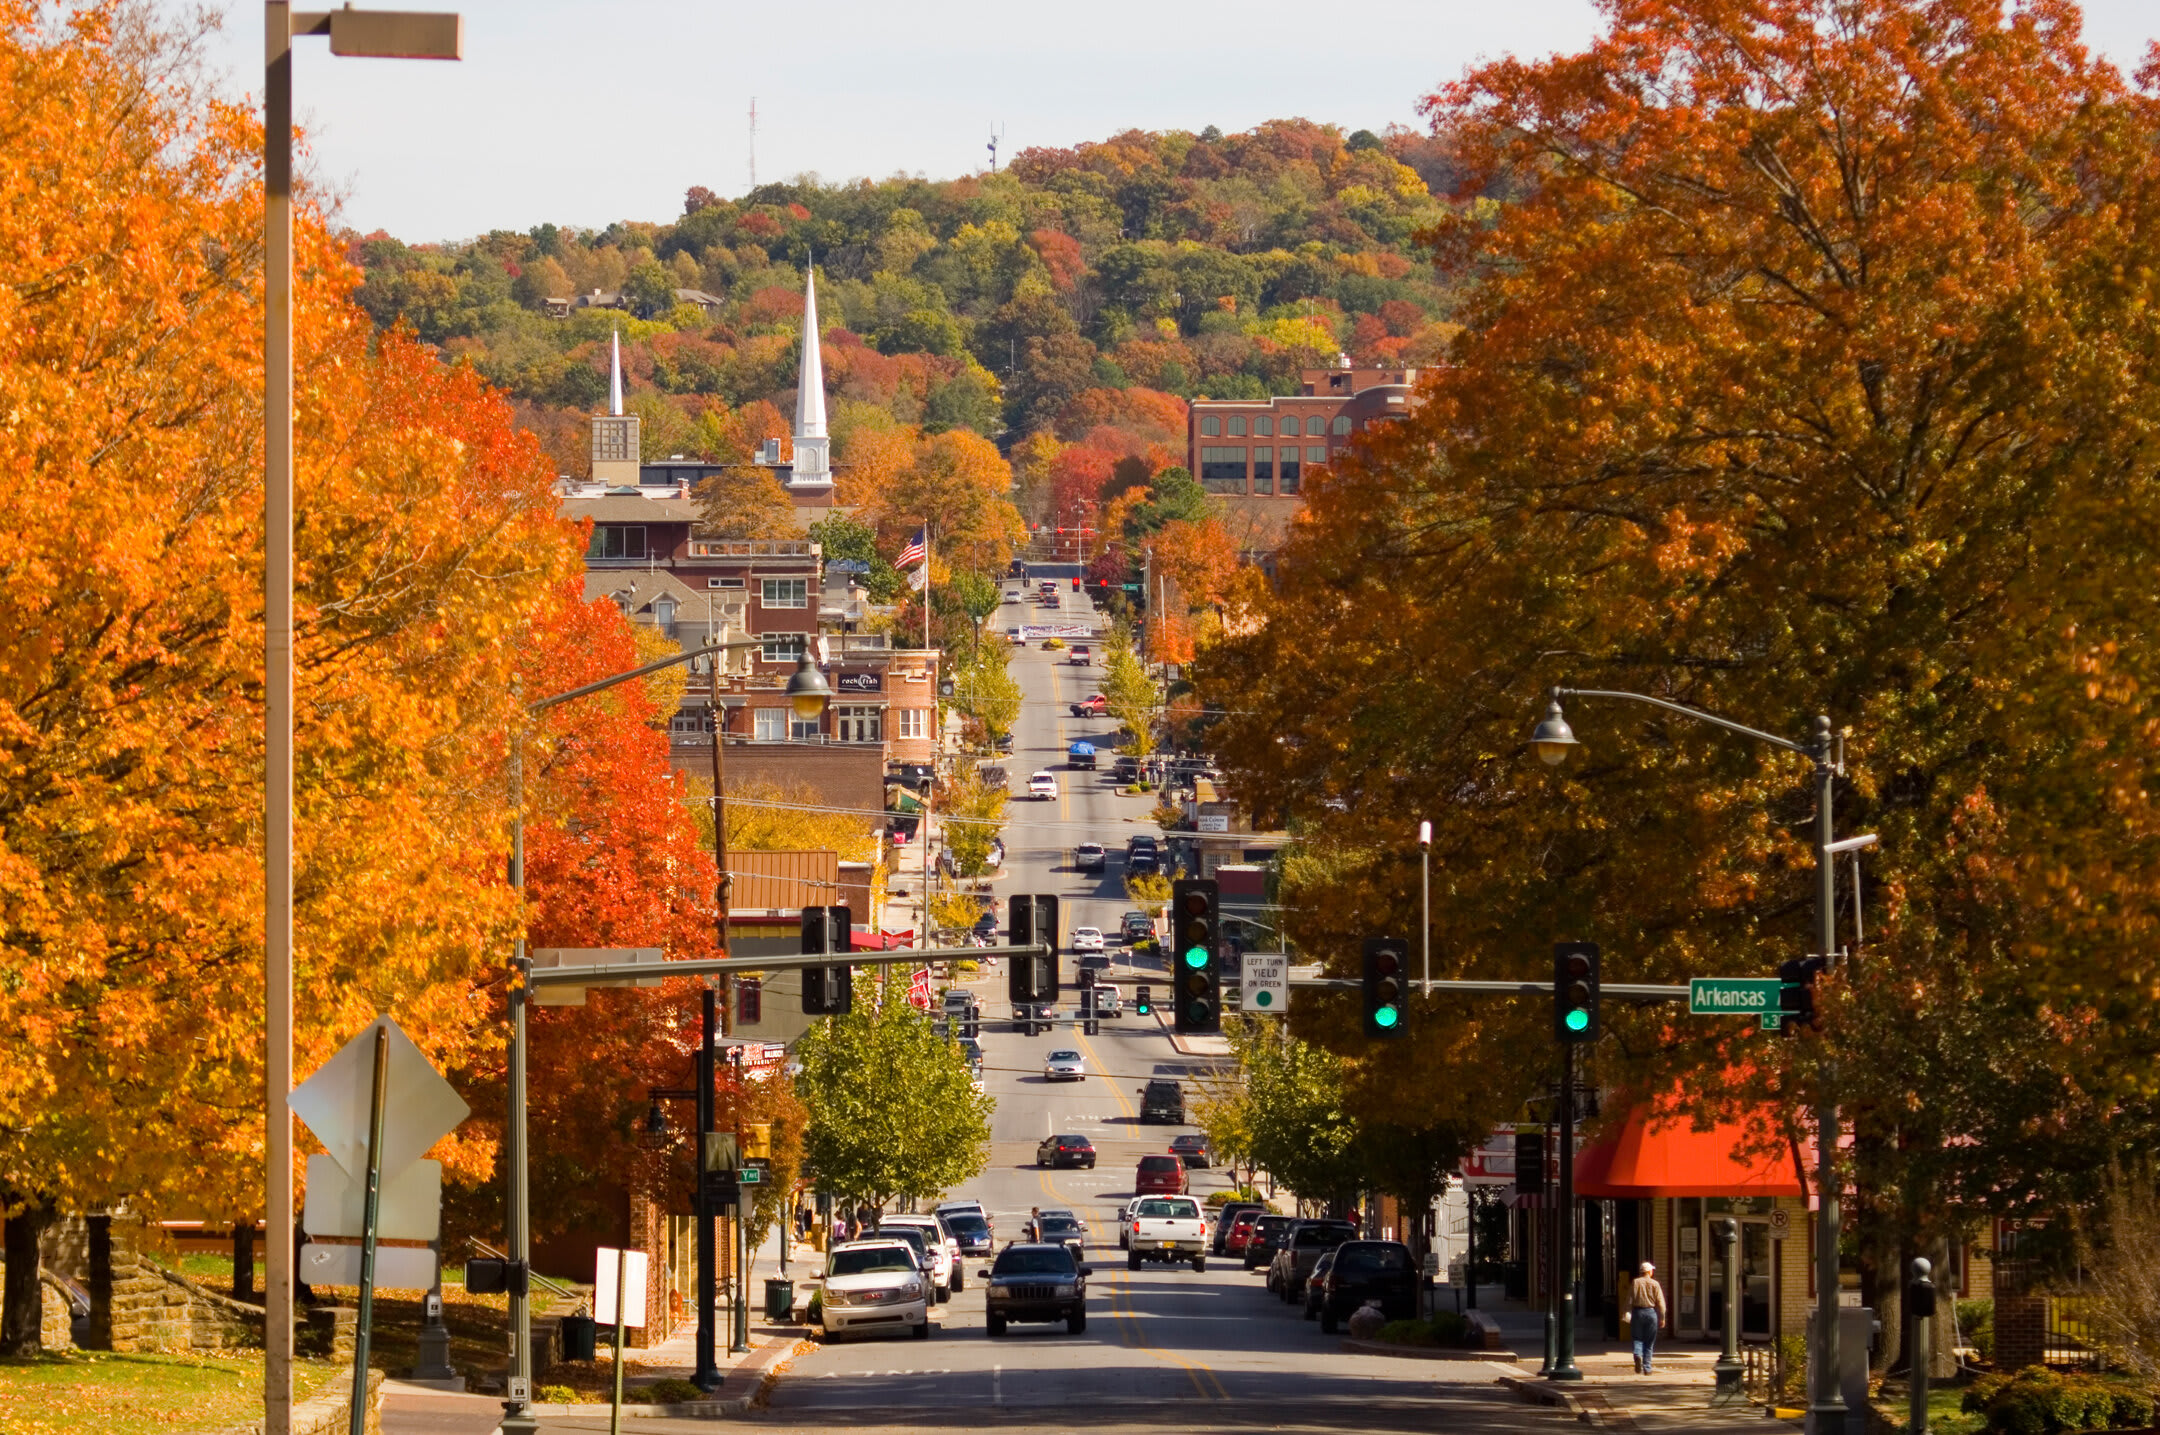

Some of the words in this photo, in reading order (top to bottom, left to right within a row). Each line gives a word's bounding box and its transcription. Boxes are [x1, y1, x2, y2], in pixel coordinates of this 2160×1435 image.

[1247, 958, 1263, 966] LEFT
[1267, 958, 1283, 966] TURN
[1252, 968, 1278, 978] YIELD
[1248, 980, 1257, 988] ON
[1260, 980, 1281, 988] GREEN
[1695, 986, 1766, 1006] Arkansas
